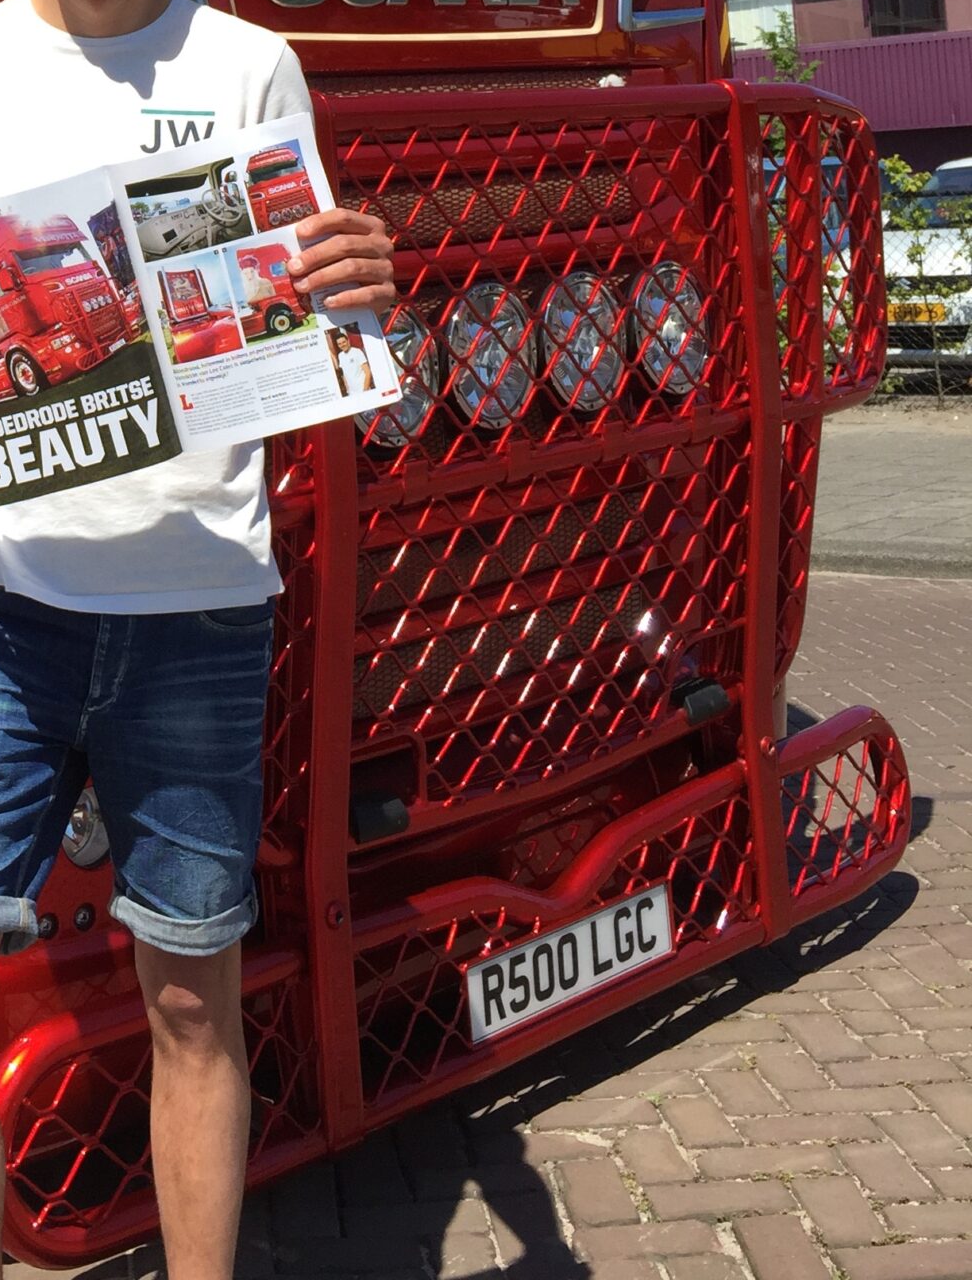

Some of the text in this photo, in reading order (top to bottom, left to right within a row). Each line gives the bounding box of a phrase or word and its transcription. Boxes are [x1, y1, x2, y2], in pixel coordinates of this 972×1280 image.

[140, 119, 215, 154] JW
[80, 375, 155, 415] BRITSE
[481, 897, 657, 1026] R500 LGC
